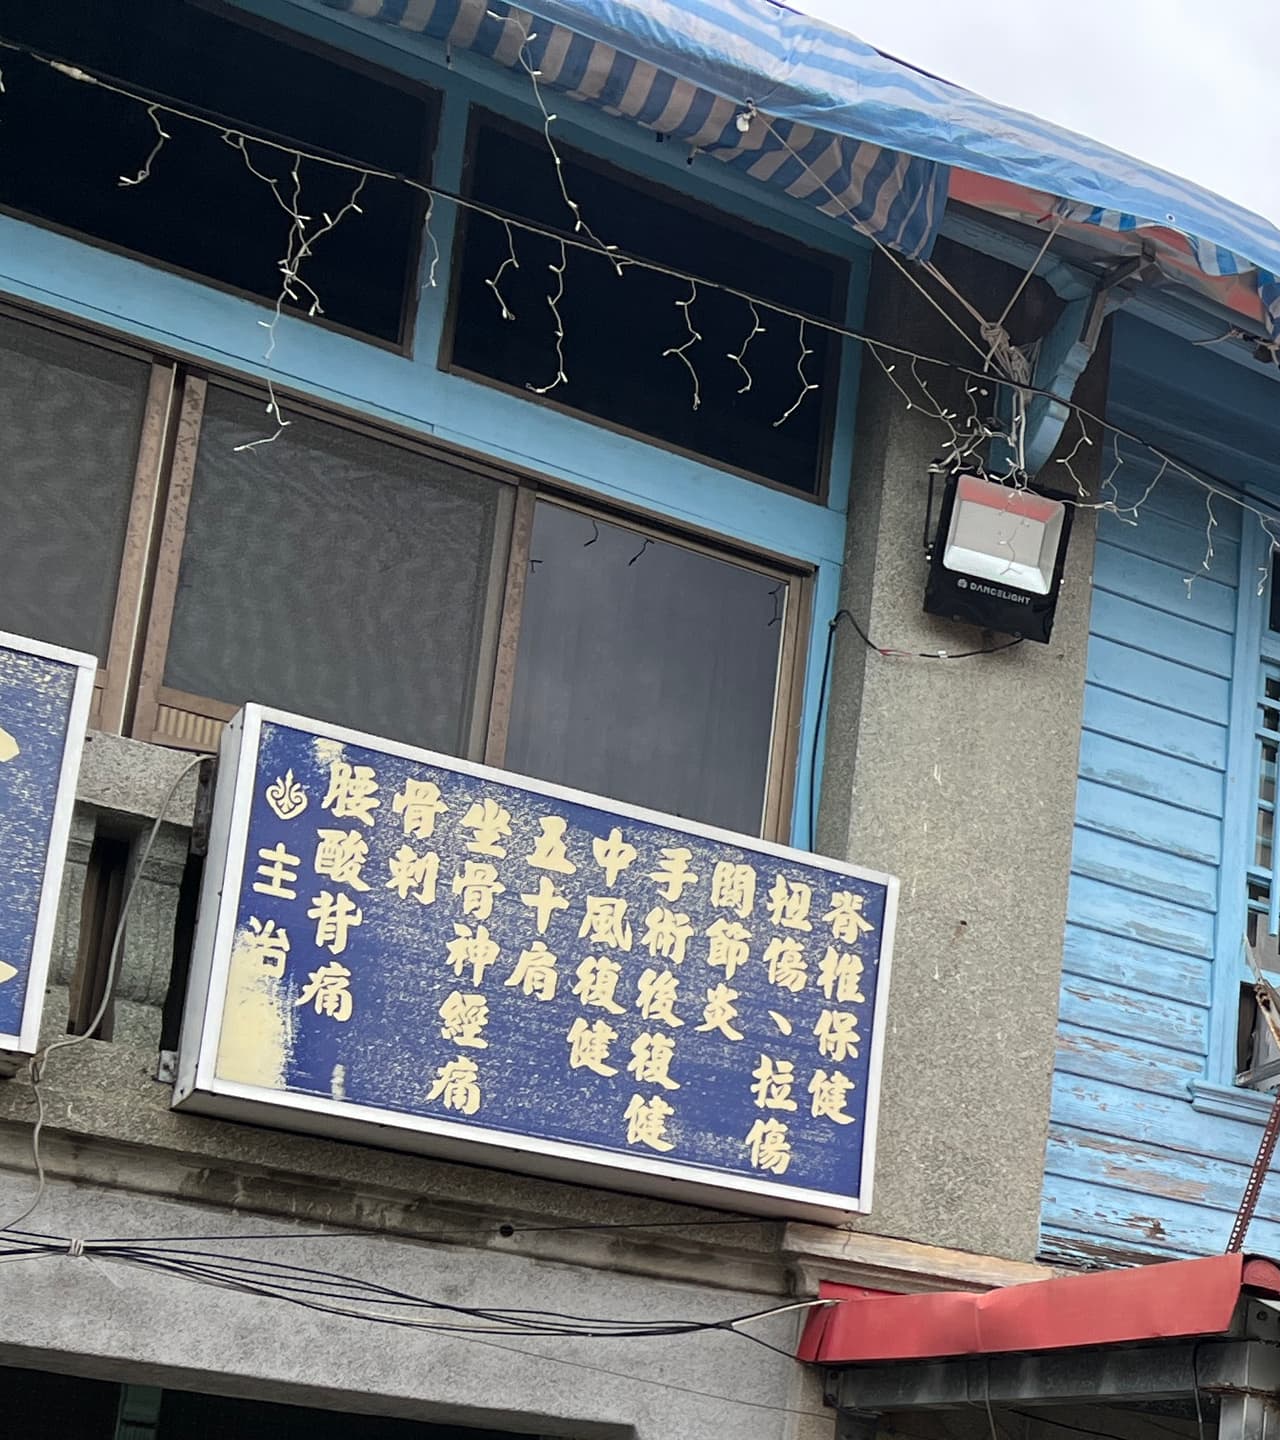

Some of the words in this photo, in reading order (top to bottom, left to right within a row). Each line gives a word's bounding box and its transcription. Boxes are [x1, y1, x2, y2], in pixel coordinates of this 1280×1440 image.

[248, 842, 301, 979] 主治
[295, 761, 381, 1022] 腰酸背痛
[385, 778, 449, 905] 骨刺
[426, 798, 512, 1116] 坐骨神經痛
[504, 815, 577, 1001] 五十肩
[567, 828, 637, 1077] 中風復健
[624, 847, 699, 1153] 手術後復健
[807, 890, 875, 1125] 脊椎保健
